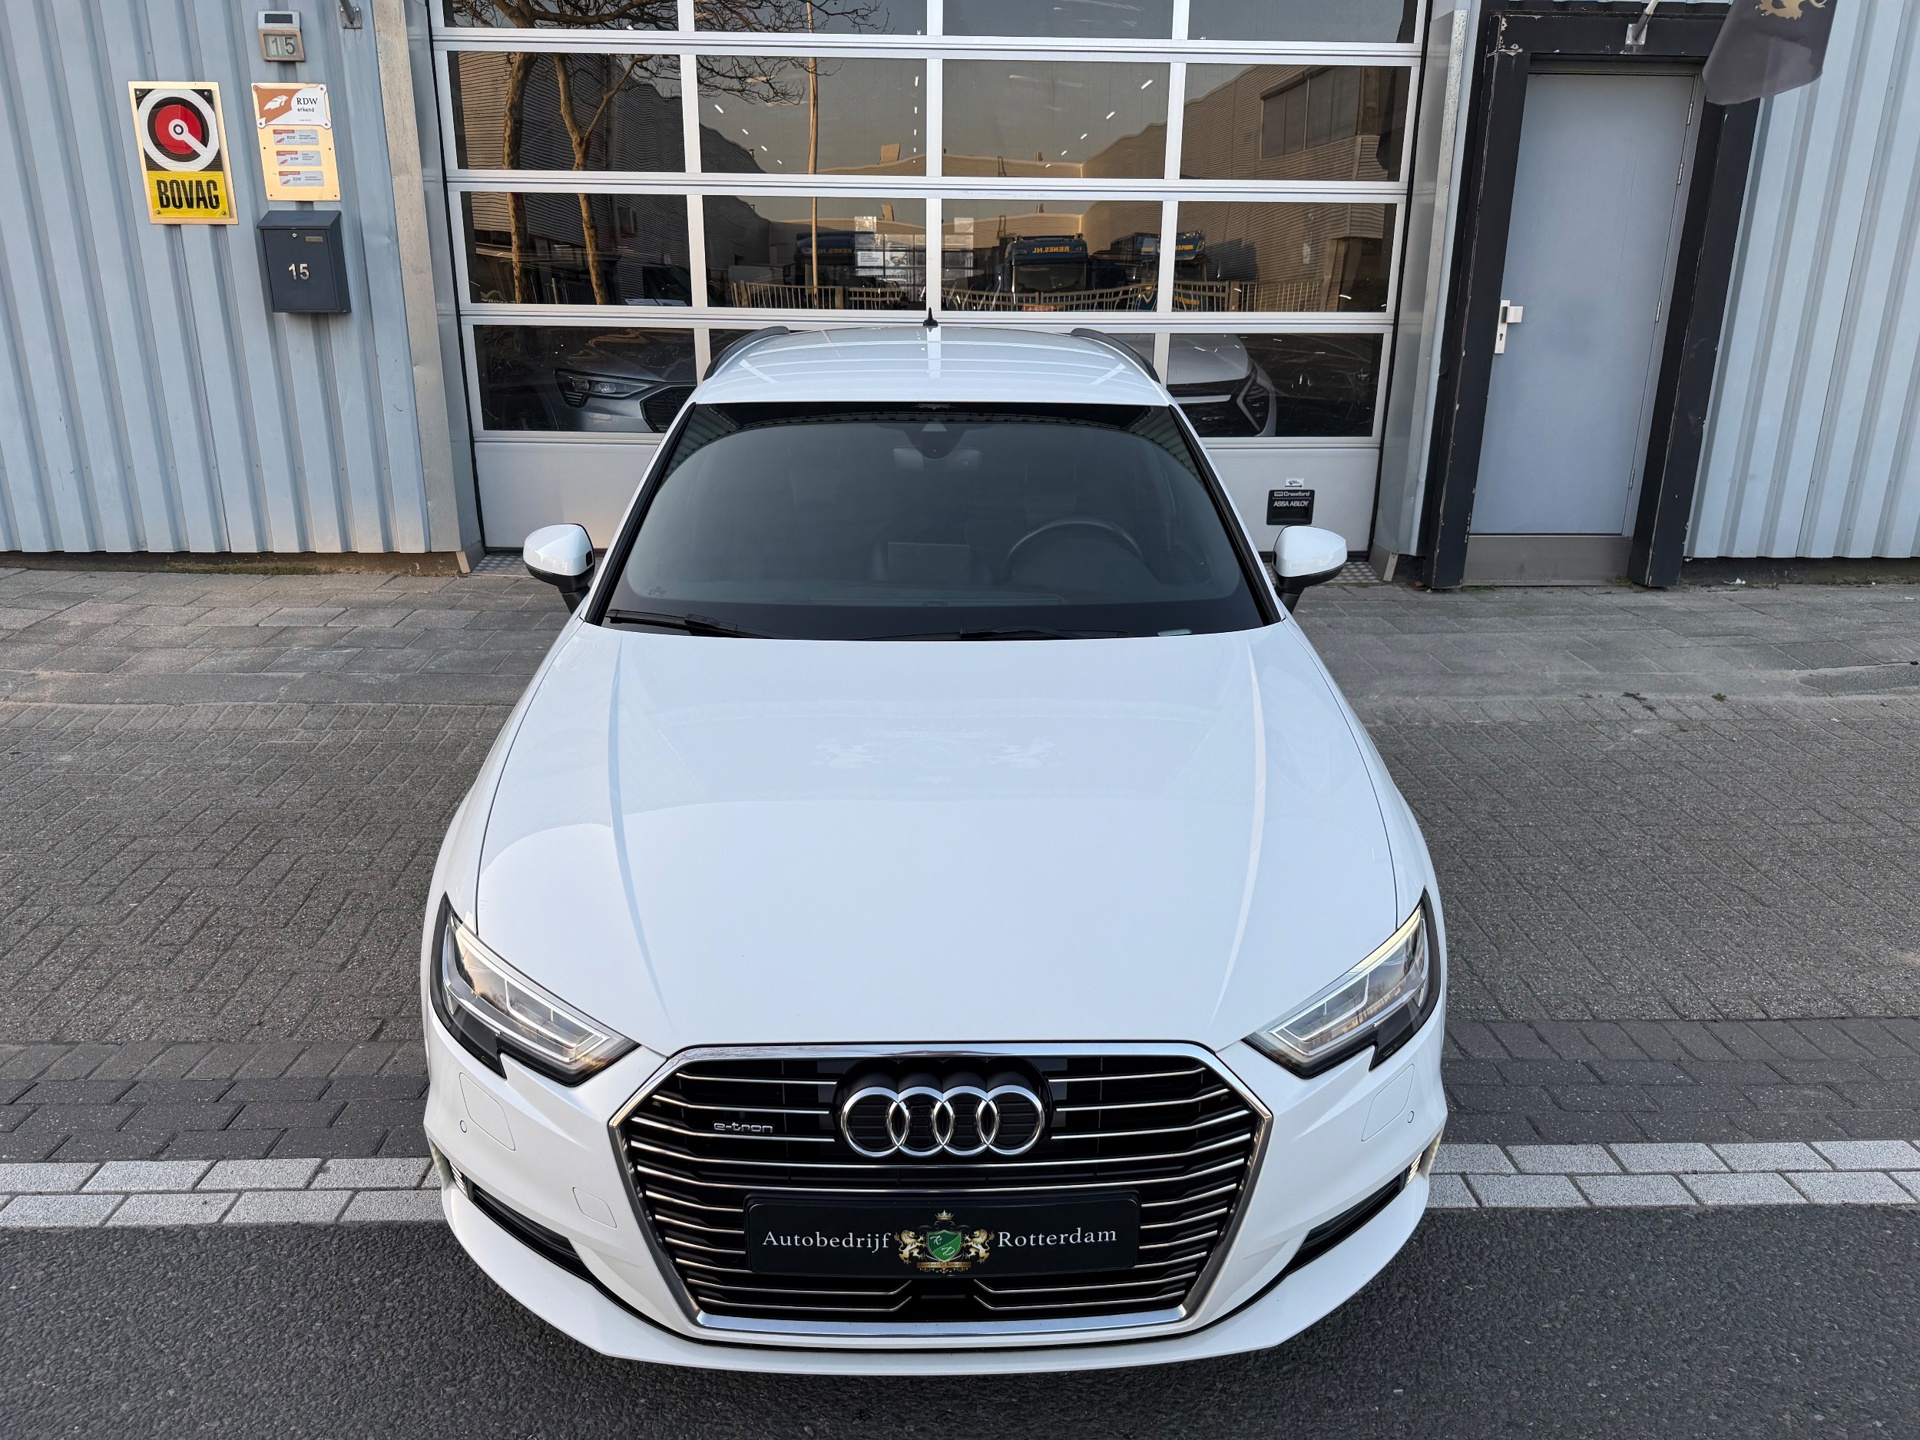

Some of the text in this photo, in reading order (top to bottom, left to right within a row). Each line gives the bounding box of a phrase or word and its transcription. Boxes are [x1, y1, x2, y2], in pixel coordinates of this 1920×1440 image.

[271, 36, 295, 55] 15
[296, 97, 318, 105] RDW
[156, 179, 220, 209] BOVAG
[288, 263, 310, 280] 15
[713, 1122, 773, 1133] e-tron
[762, 1231, 892, 1254] Autobedrijf
[997, 1227, 1117, 1247] Rotterdam
